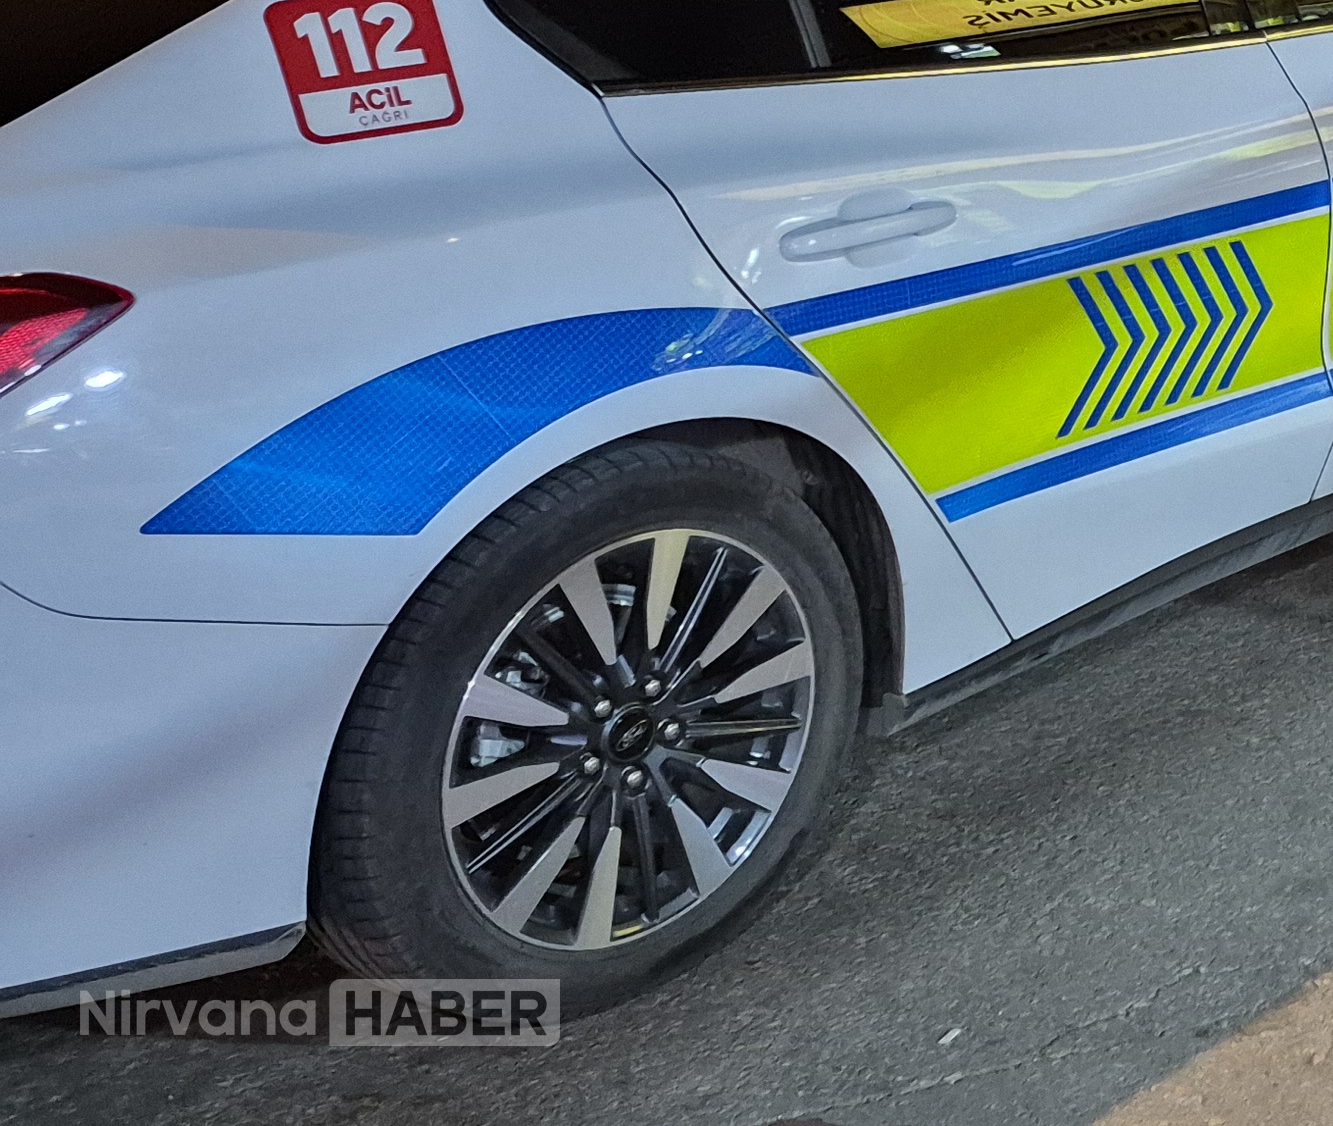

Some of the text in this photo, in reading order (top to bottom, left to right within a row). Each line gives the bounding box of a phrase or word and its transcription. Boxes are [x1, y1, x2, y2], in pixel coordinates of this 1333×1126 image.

[293, 1, 428, 79] 112
[349, 85, 412, 114] ACİL
[358, 110, 410, 127] ÇAĞRI
